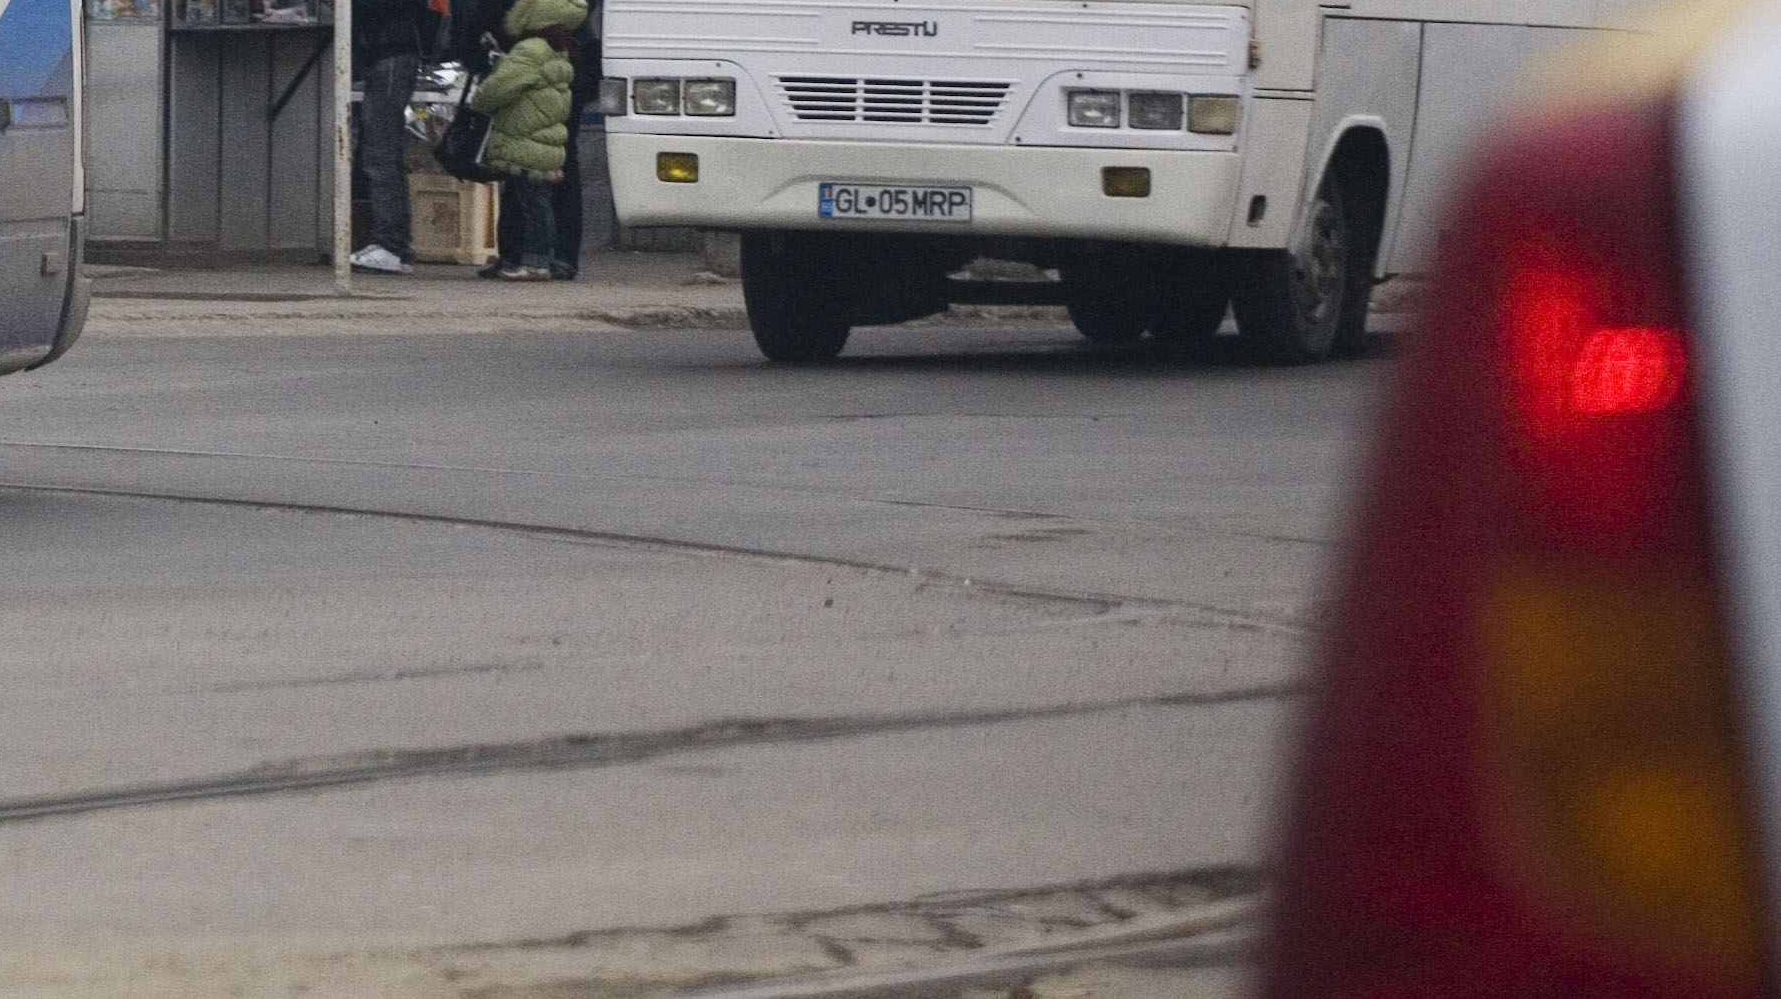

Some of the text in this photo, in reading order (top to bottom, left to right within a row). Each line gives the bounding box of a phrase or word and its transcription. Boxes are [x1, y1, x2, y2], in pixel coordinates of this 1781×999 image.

[835, 188, 867, 214] GL
[879, 189, 908, 215] 05
[911, 190, 967, 216] MRP
